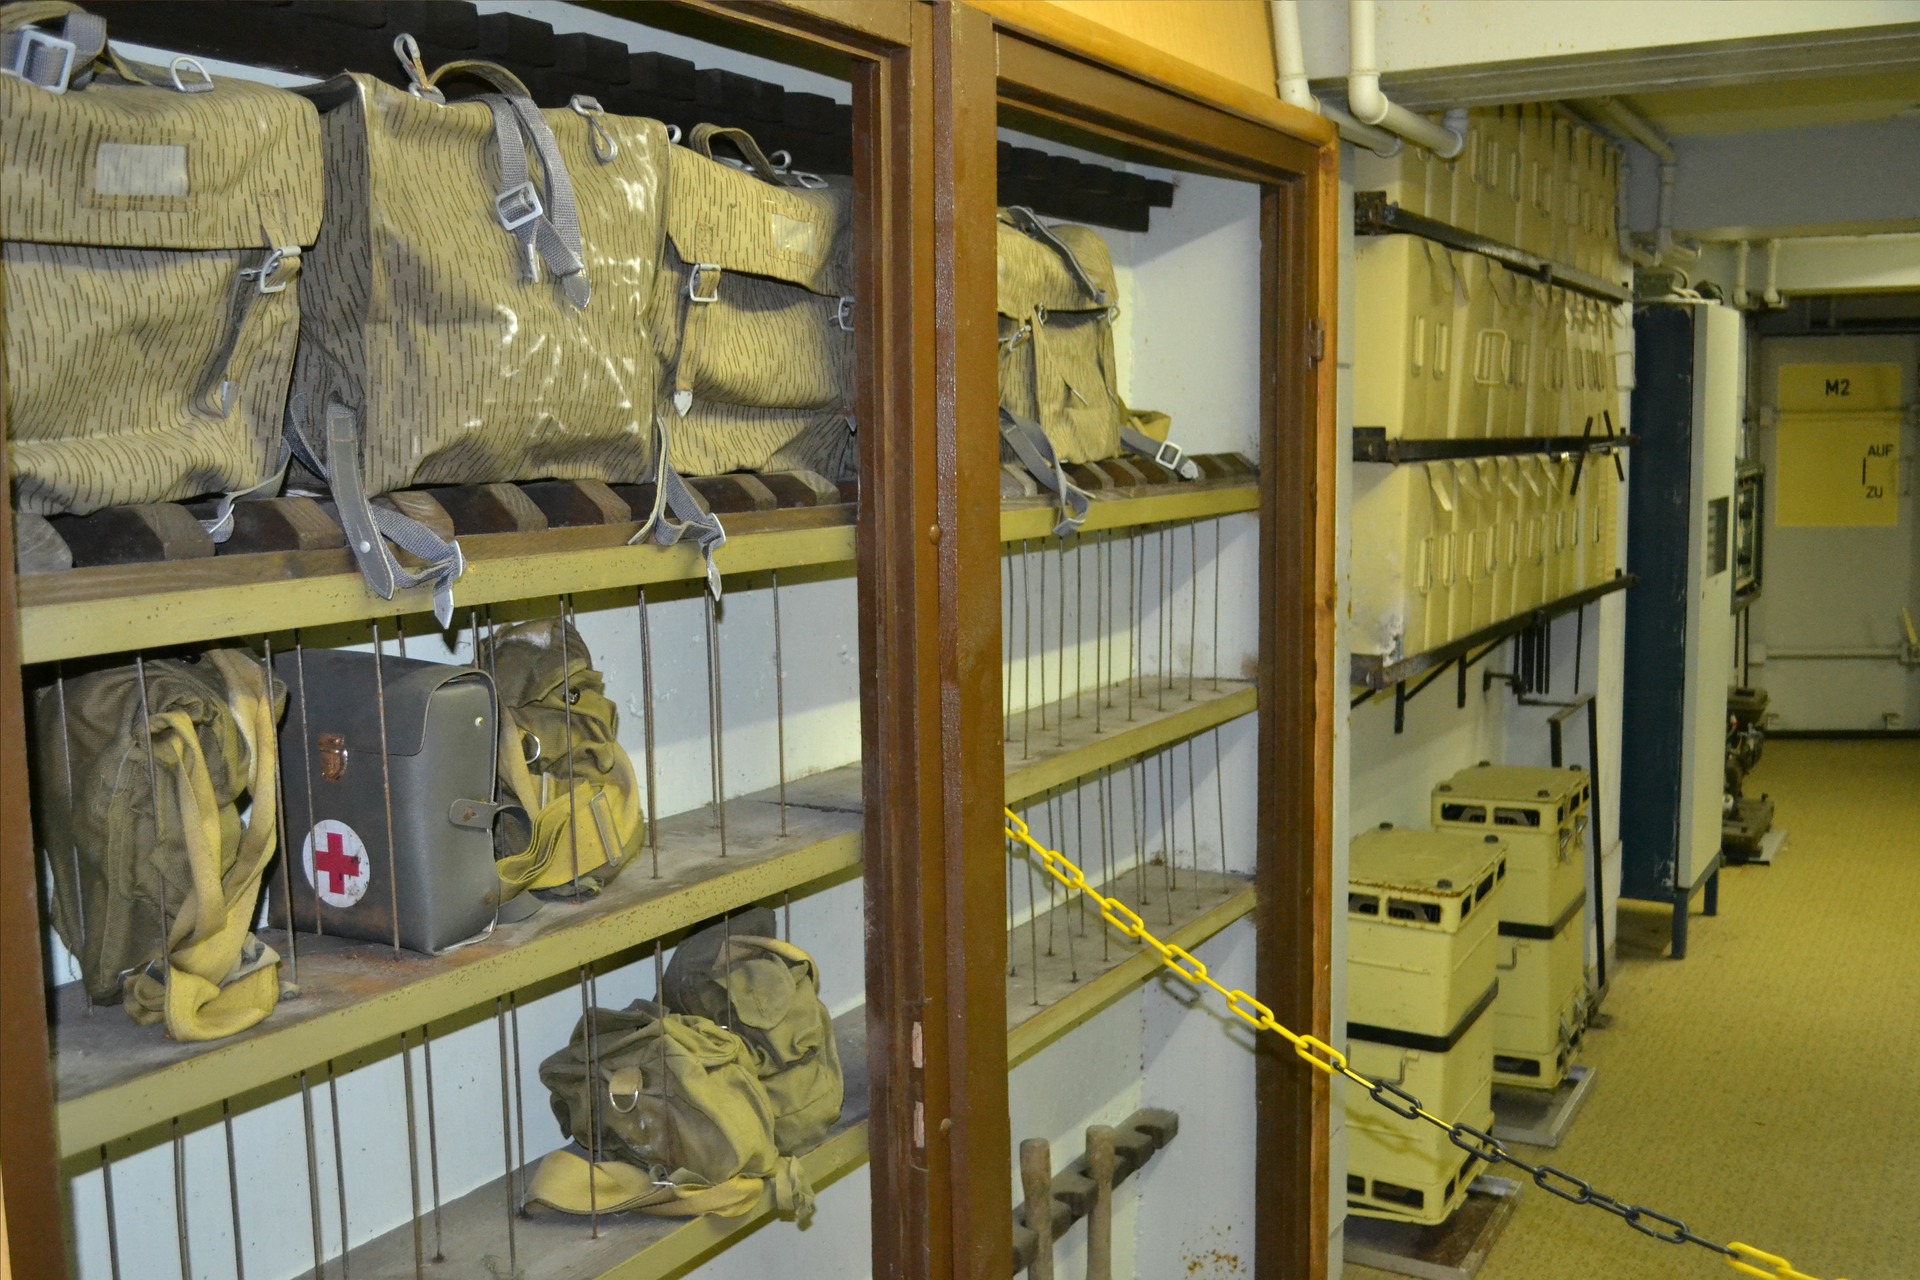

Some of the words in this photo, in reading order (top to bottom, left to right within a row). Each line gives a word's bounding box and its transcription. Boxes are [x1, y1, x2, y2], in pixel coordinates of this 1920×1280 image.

[1825, 379, 1850, 396] M2
[1867, 444, 1894, 457] AUF
[1866, 486, 1884, 499] ZU
